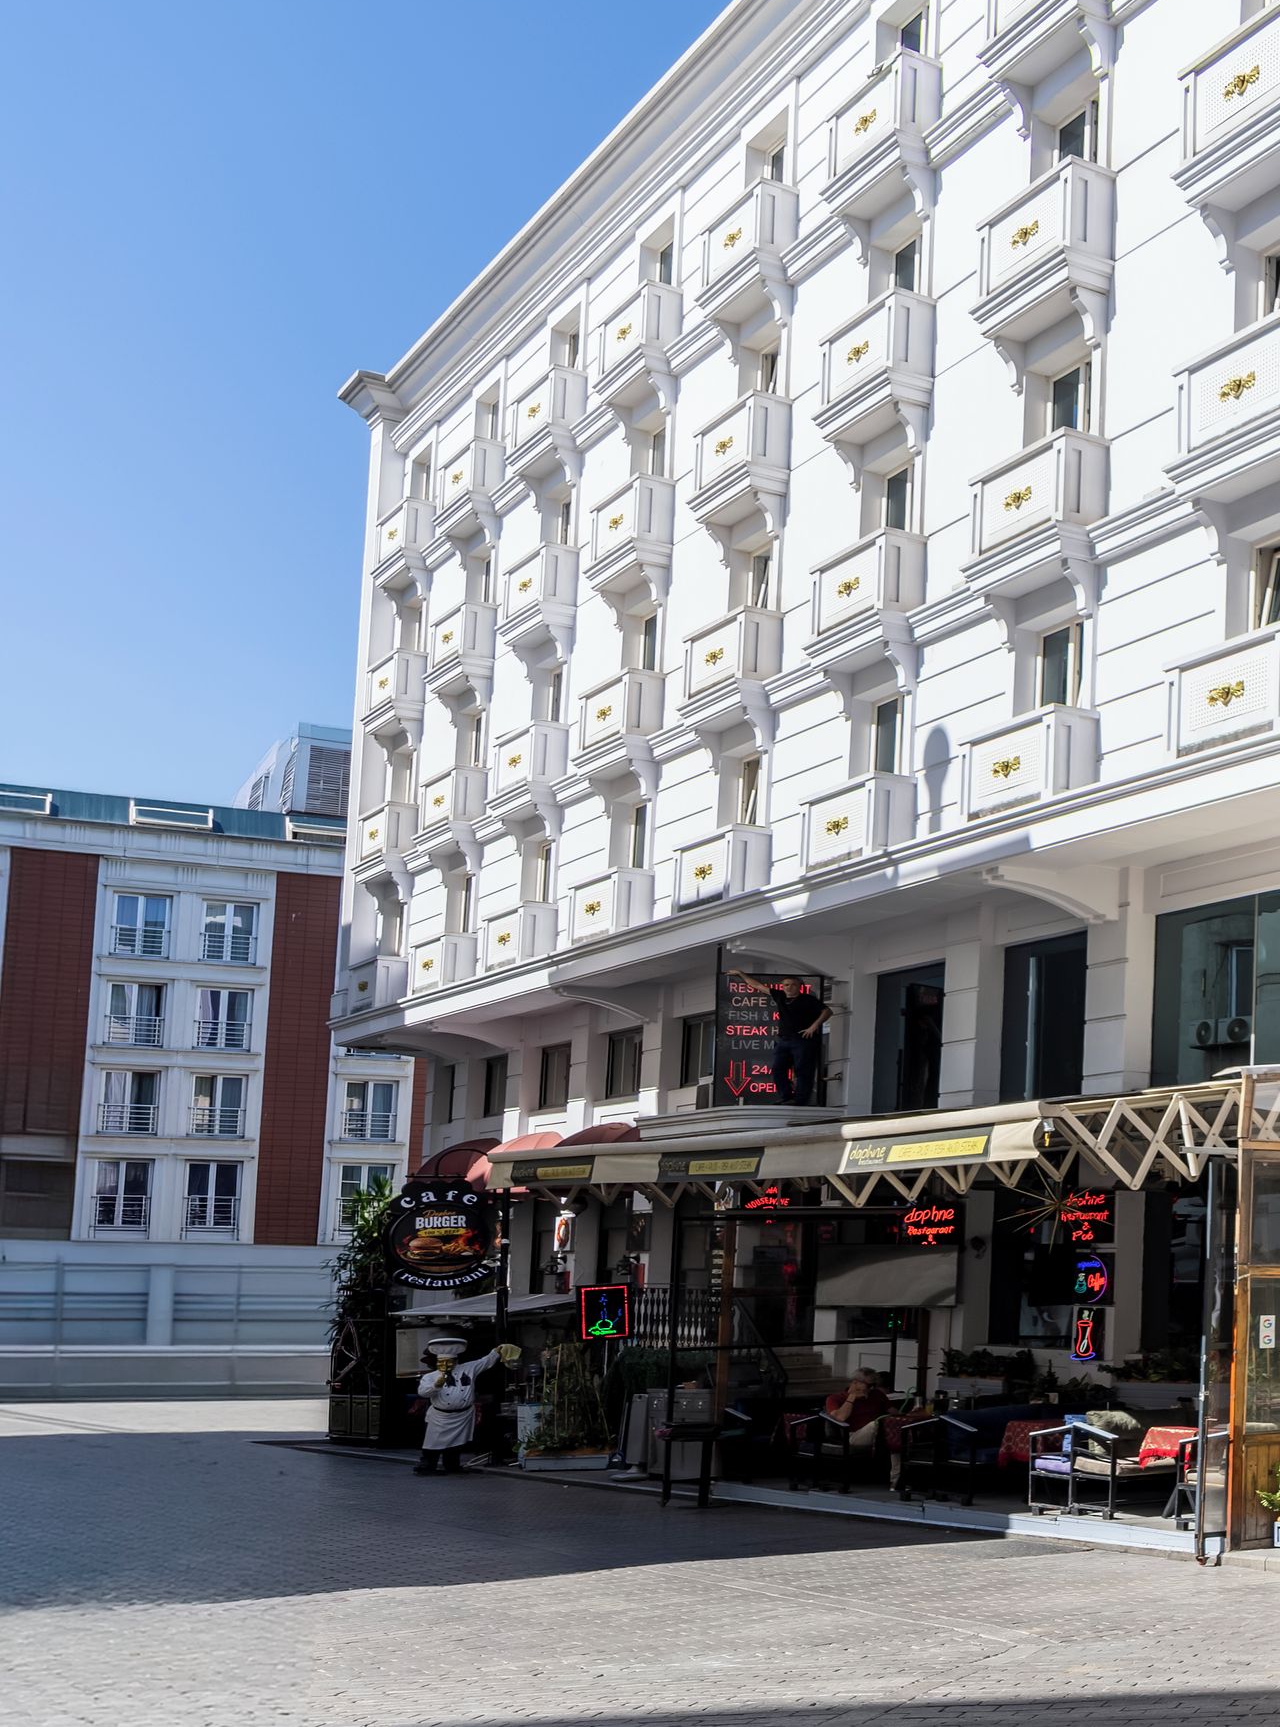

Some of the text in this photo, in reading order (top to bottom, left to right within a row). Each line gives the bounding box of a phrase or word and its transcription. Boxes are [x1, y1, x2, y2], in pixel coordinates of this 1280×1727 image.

[731, 996, 768, 1007] CAFE
[728, 1010, 758, 1021] FISH
[762, 1011, 769, 1021] &
[725, 1025, 768, 1036] STEAK
[731, 1039, 760, 1050] LIVE
[400, 1190, 478, 1208] cafe
[904, 1205, 955, 1224] daphne
[415, 1215, 467, 1229] BURGER
[400, 1267, 489, 1287] restaurant
